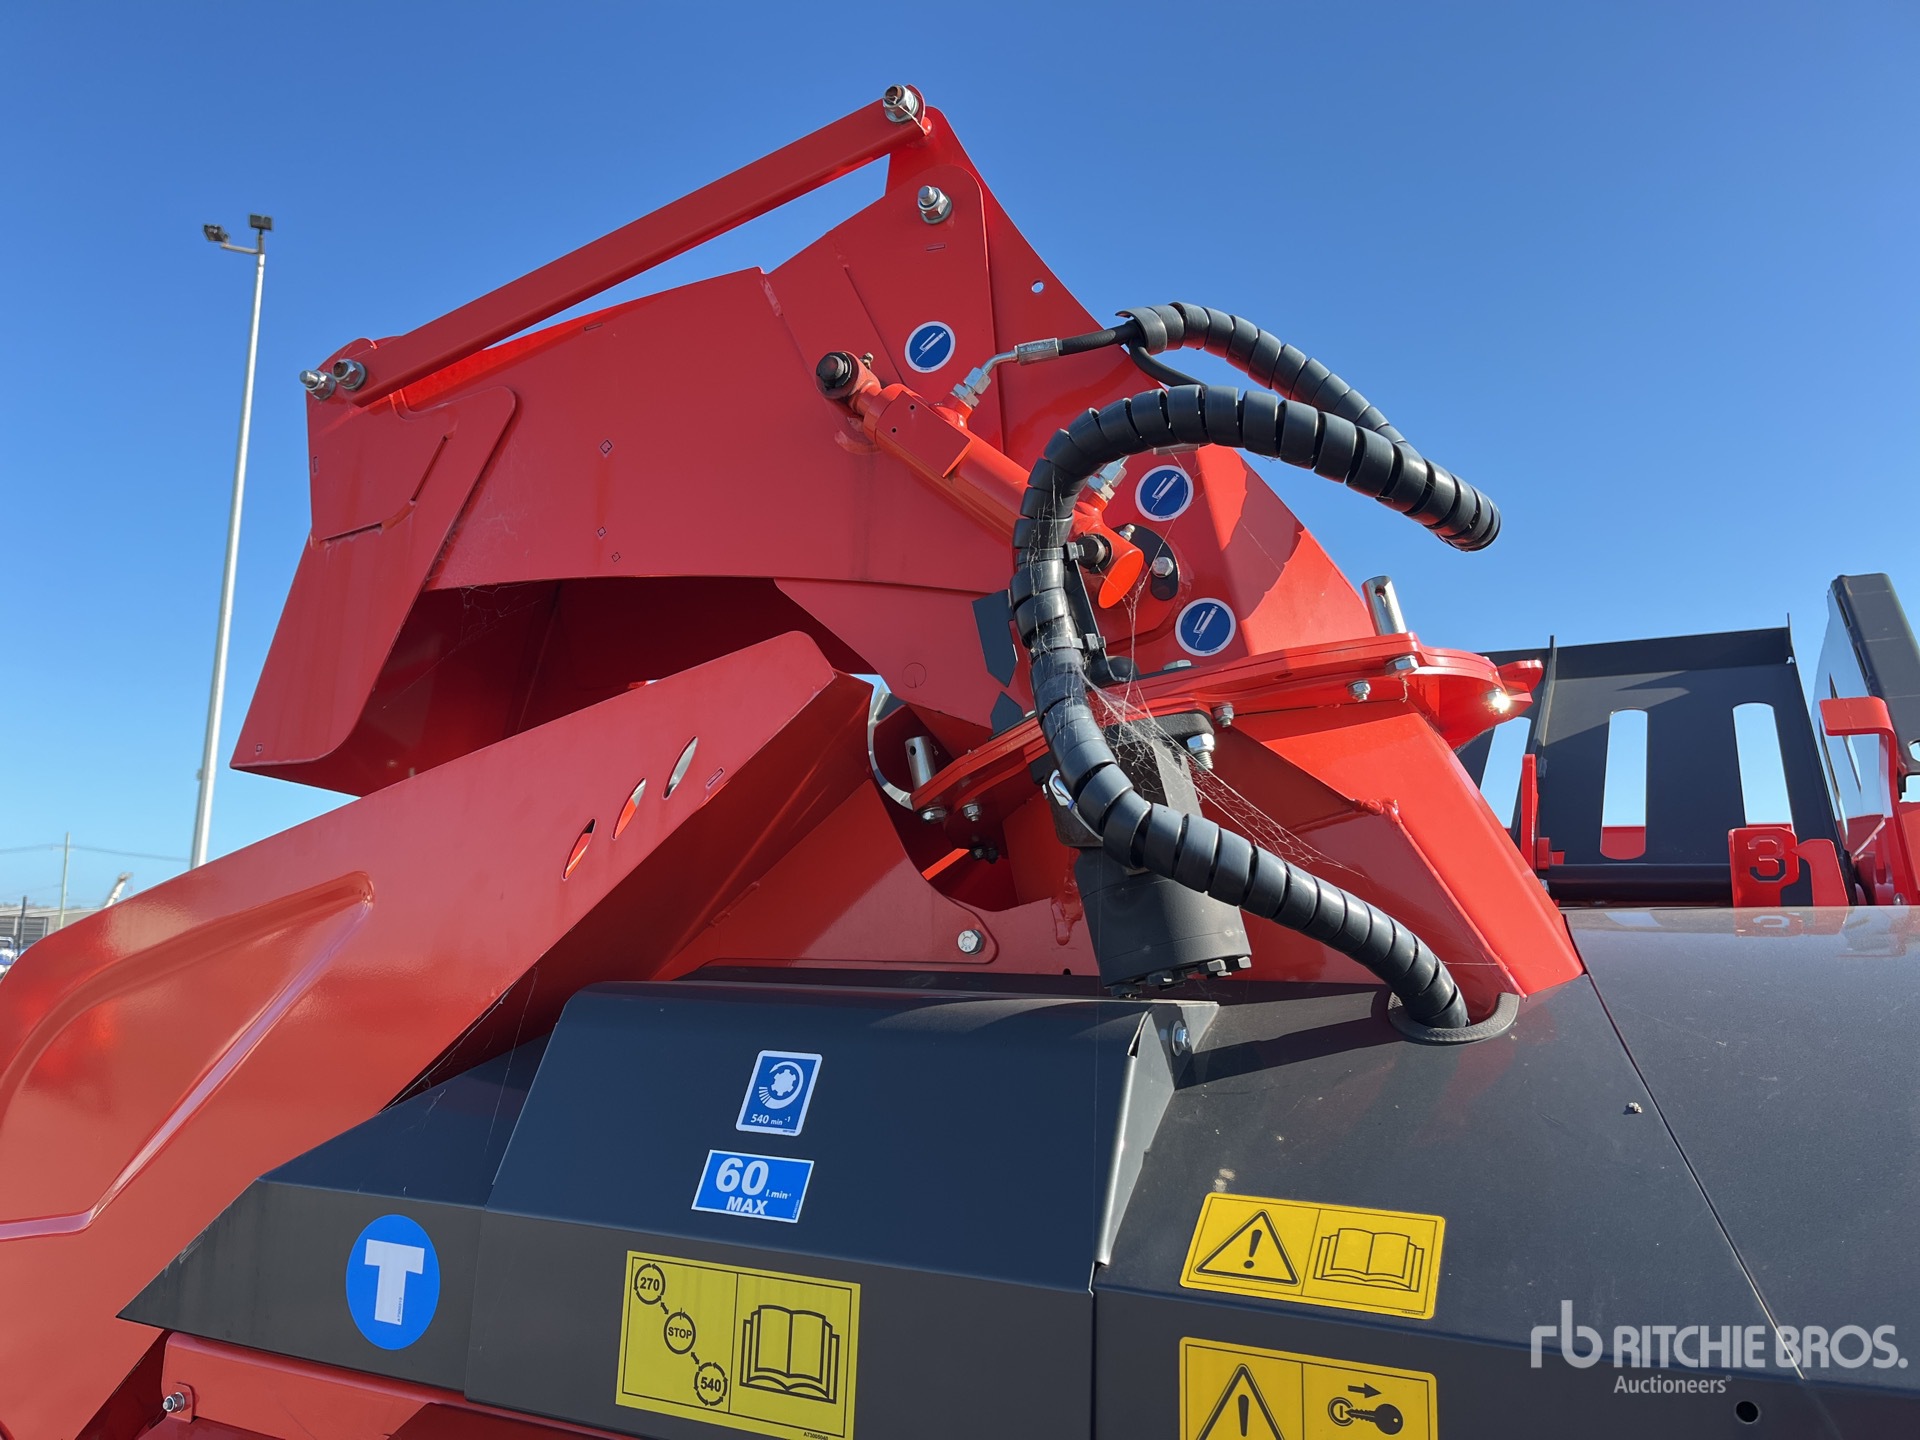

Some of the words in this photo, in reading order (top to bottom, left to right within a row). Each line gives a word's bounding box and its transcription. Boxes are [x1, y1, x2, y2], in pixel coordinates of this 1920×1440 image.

[1747, 835, 1787, 882] 3
[750, 1113, 770, 1124] 540
[715, 1157, 769, 1196] 60
[726, 1196, 768, 1215] MAX
[364, 1238, 425, 1326] T
[639, 1276, 660, 1292] 270
[667, 1326, 693, 1340] STOP
[700, 1376, 722, 1392] 540
